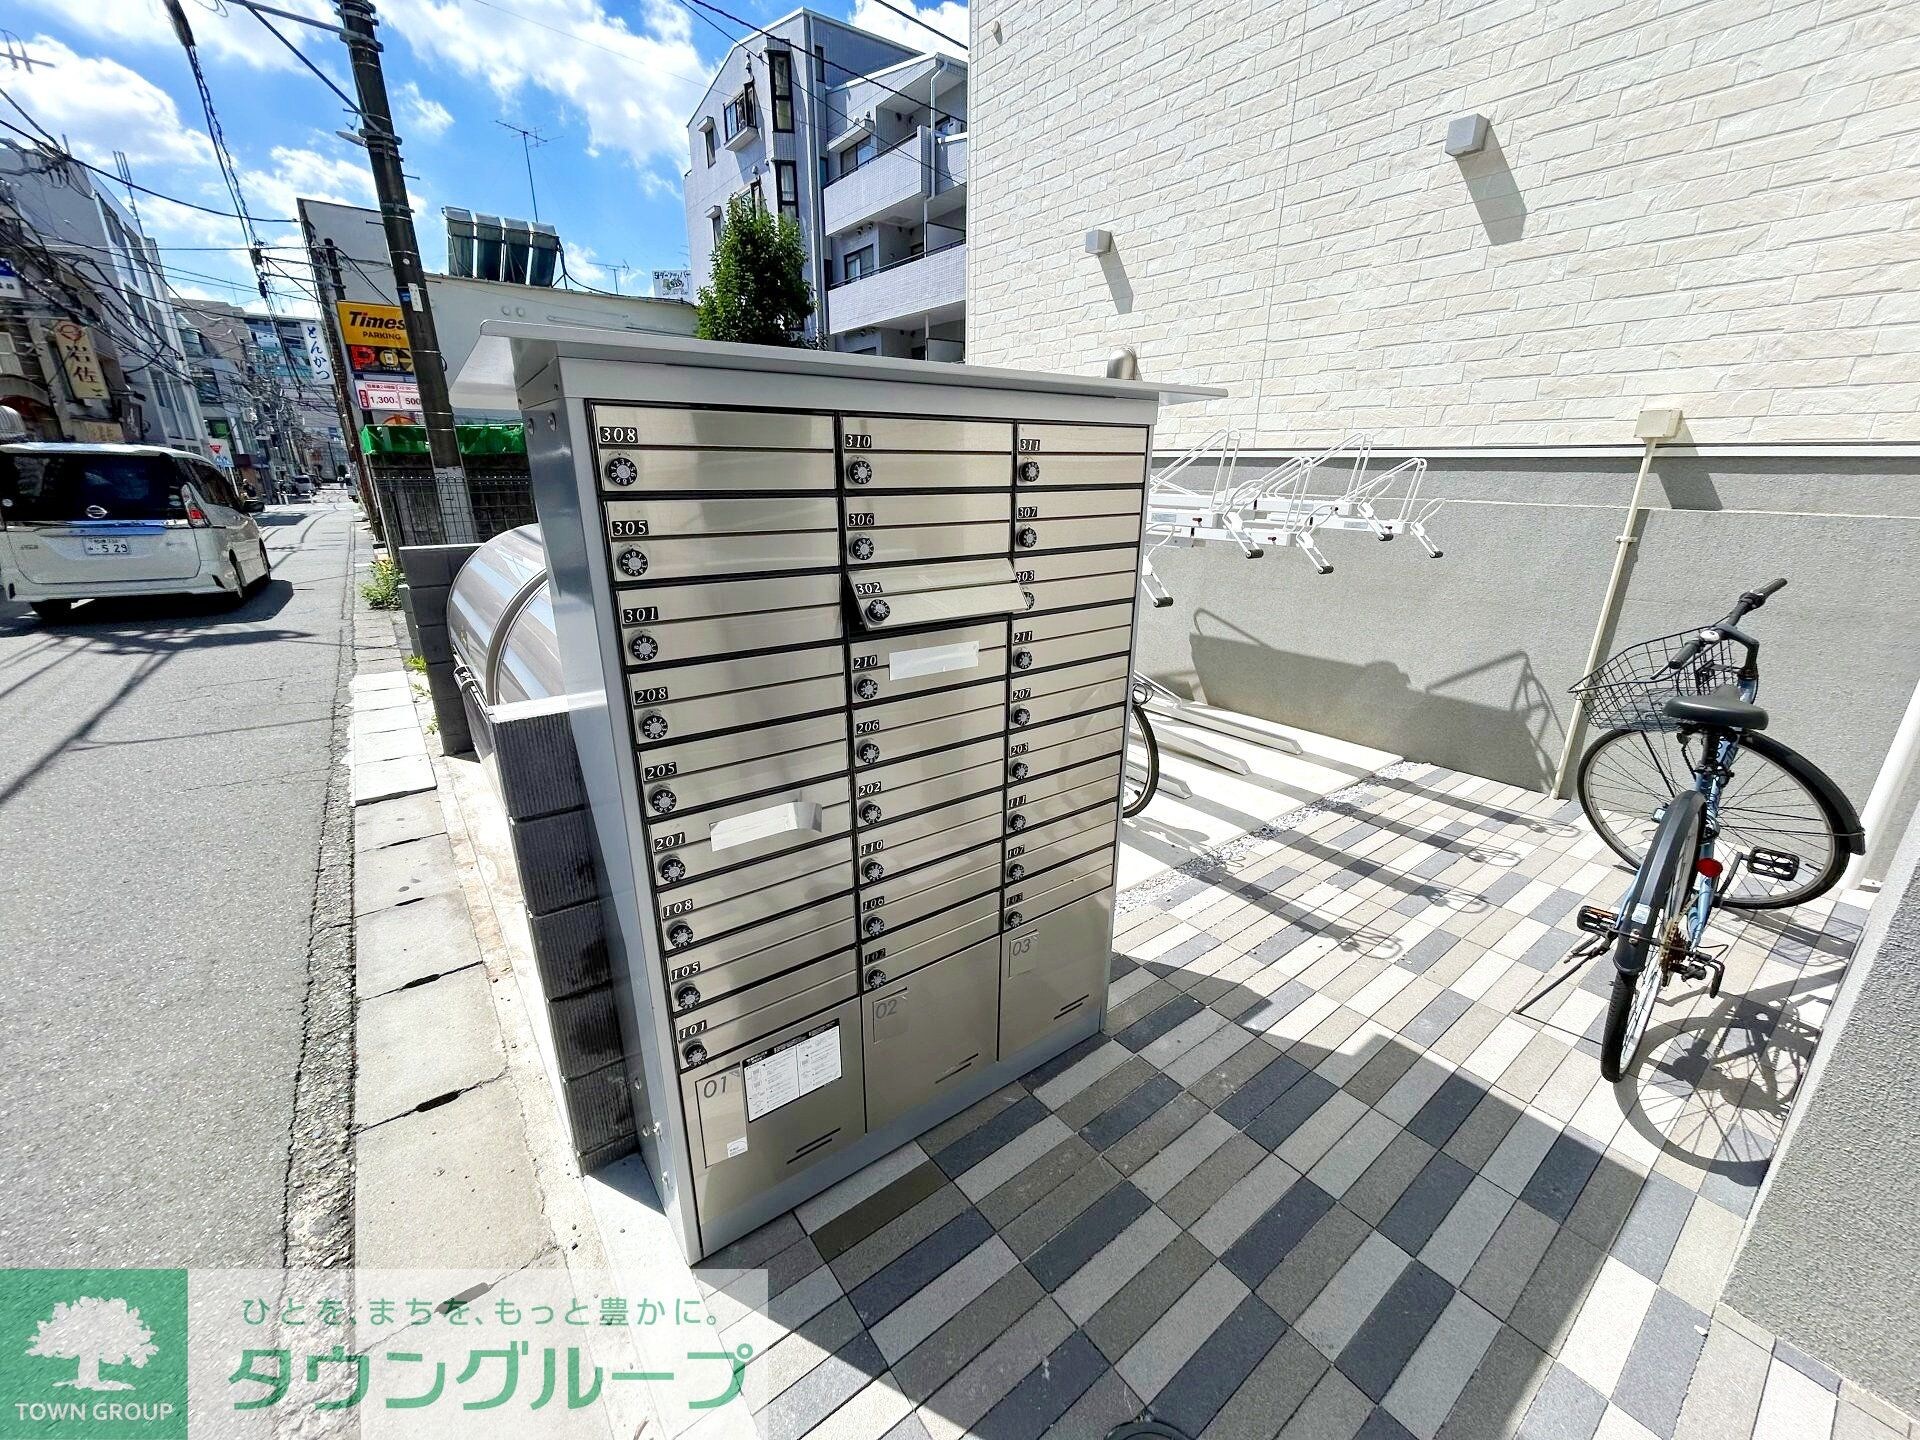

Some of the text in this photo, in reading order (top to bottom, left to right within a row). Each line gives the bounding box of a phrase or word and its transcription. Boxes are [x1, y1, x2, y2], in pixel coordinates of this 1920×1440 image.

[349, 311, 405, 329] Times
[363, 331, 402, 340] PARKING
[307, 326, 331, 380] とんかつ
[602, 428, 636, 442] 308
[846, 435, 871, 448] 310
[1021, 440, 1040, 450] 311
[1018, 507, 1037, 518] 307
[850, 514, 874, 526] 306
[614, 521, 646, 535] 305
[1016, 572, 1034, 581] 303
[857, 582, 881, 594] 302
[625, 608, 656, 623] 301
[1014, 632, 1033, 642] 211
[854, 656, 877, 669] 210
[637, 688, 667, 703] 208
[1014, 689, 1031, 700] 207
[857, 721, 879, 734] 206
[1011, 743, 1028, 754] 203
[647, 763, 676, 779] 205
[860, 782, 881, 796] 202
[1010, 796, 1026, 808] 111
[656, 833, 684, 849] 201
[862, 841, 883, 855] 110
[664, 900, 692, 917] 108
[864, 897, 885, 911] 106
[1011, 939, 1031, 957] 03
[672, 963, 699, 980] 105
[875, 1000, 897, 1019] 02
[681, 1021, 706, 1039] 101
[703, 1076, 727, 1098] 01
